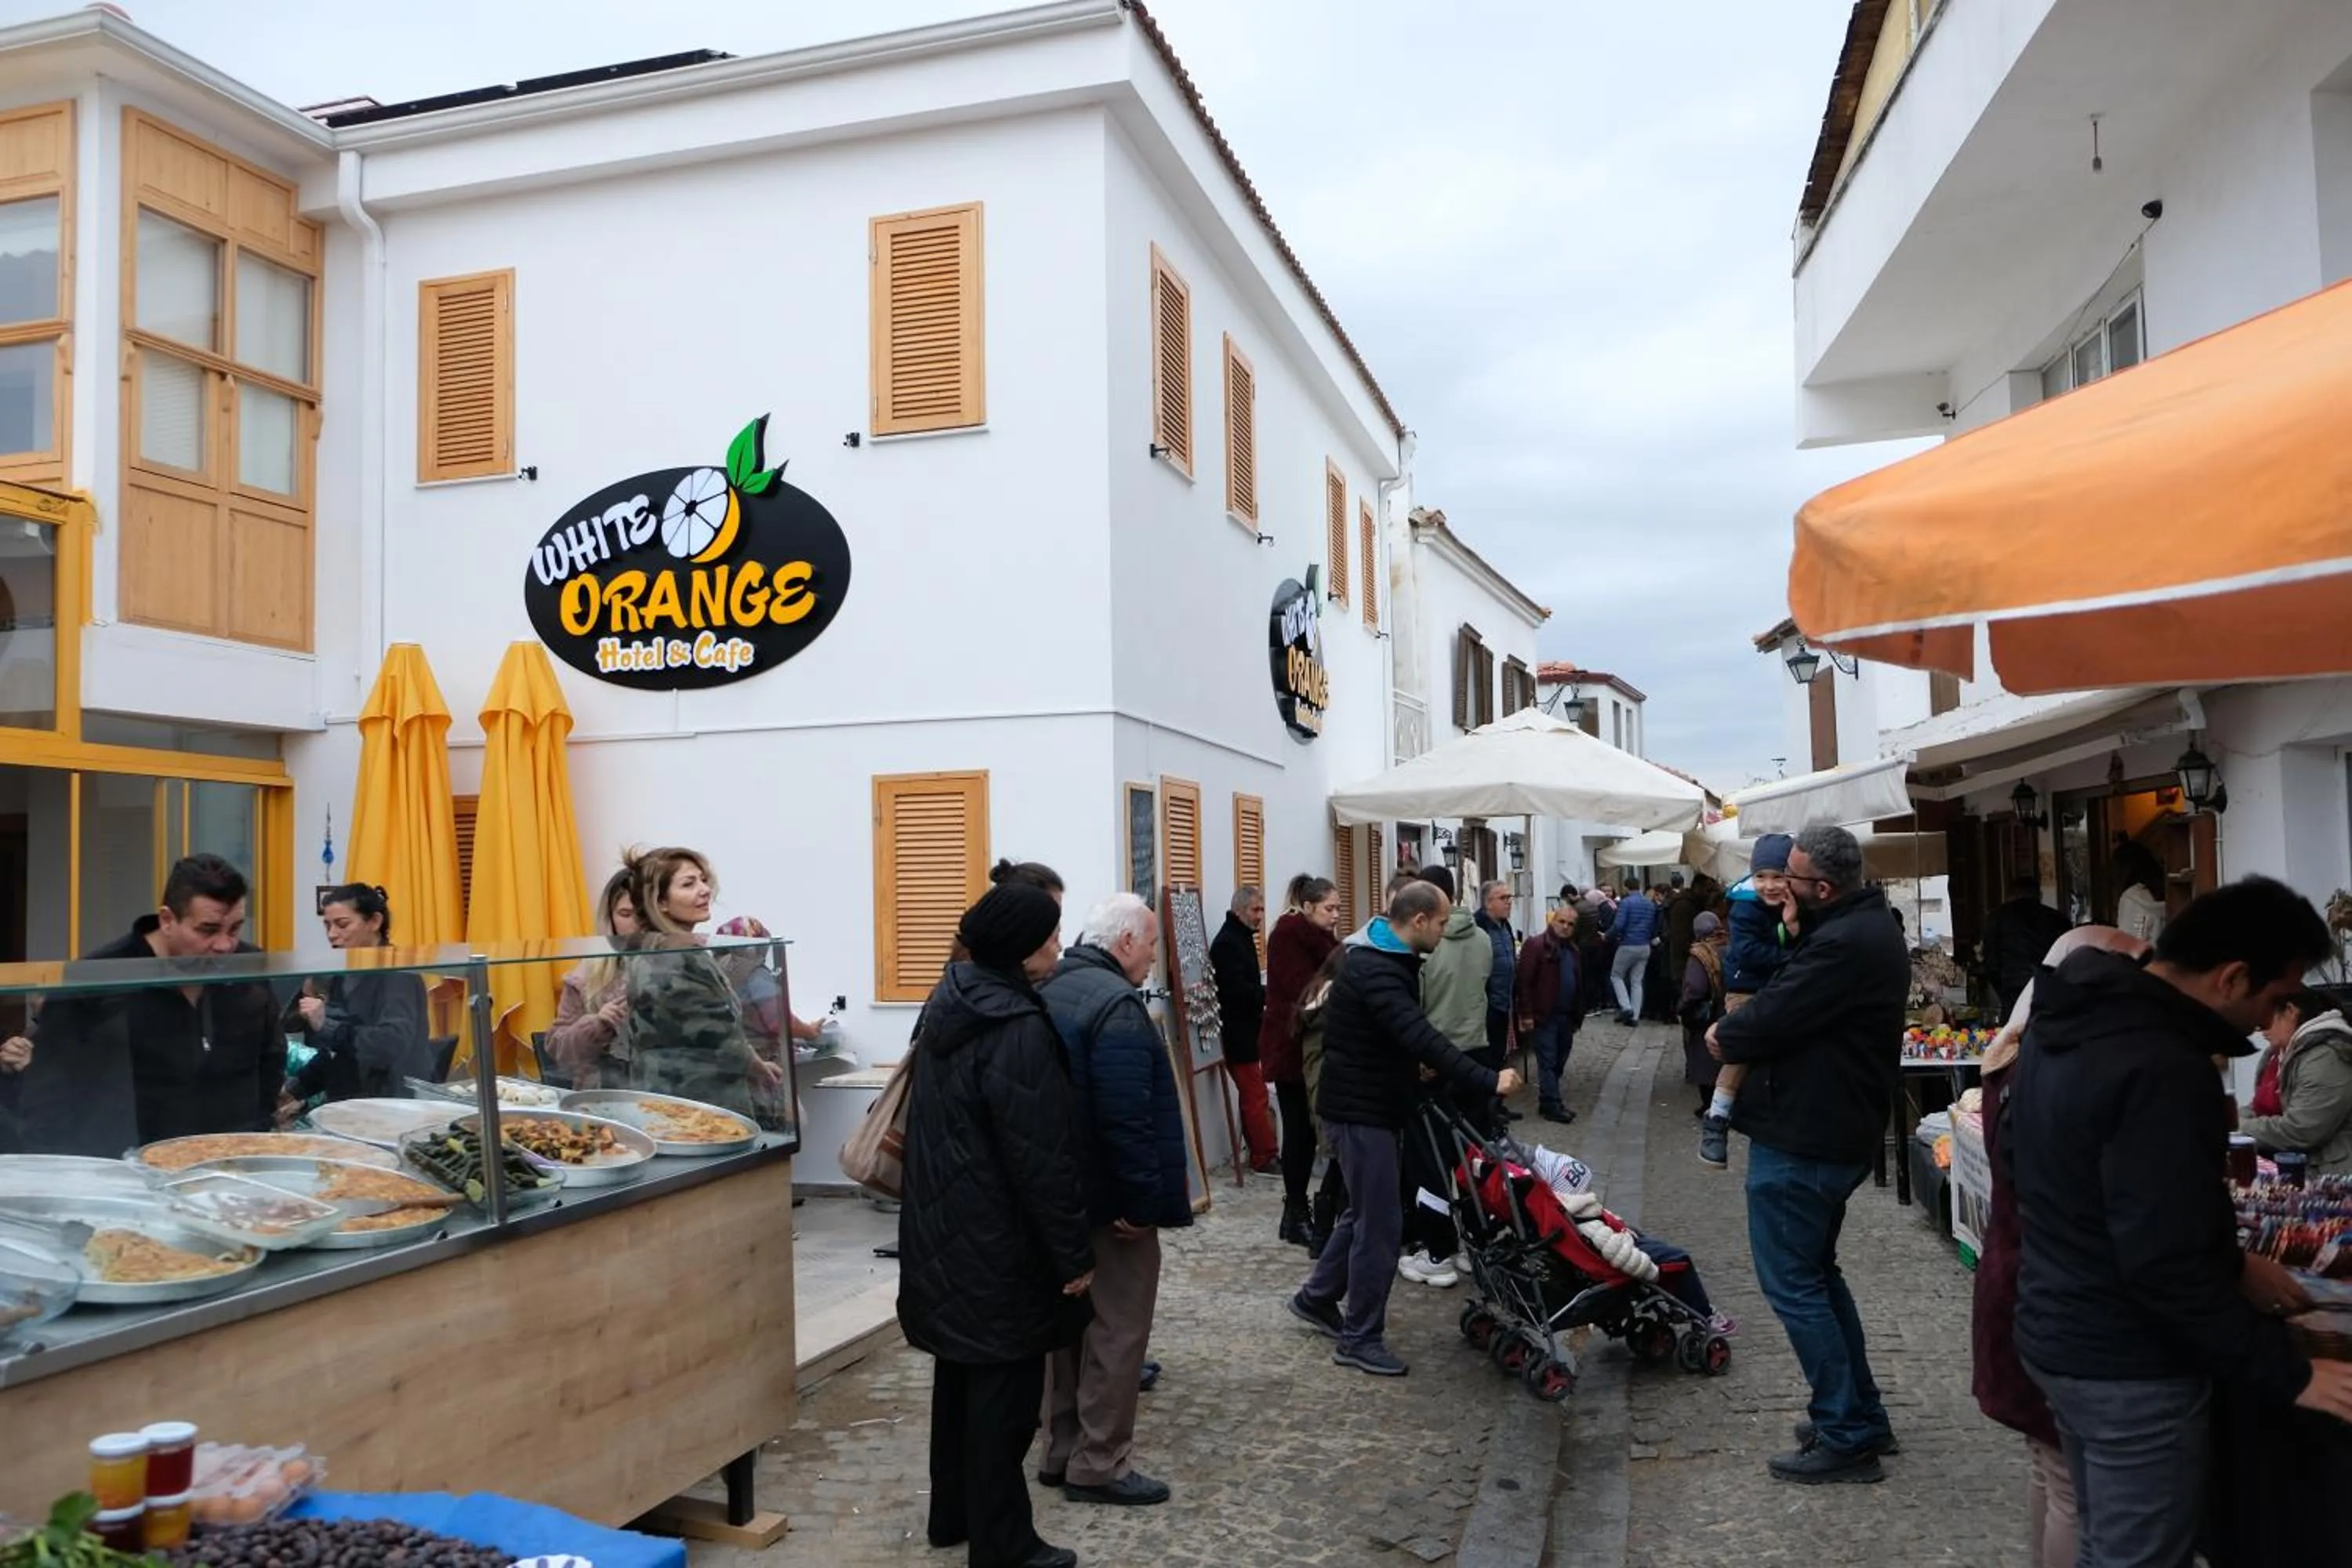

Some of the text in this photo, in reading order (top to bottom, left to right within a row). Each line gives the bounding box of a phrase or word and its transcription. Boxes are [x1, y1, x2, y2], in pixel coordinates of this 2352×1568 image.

[532, 495, 658, 586] WHITE
[560, 561, 816, 636] ORANGE
[596, 630, 755, 673] Hotel & Cafe
